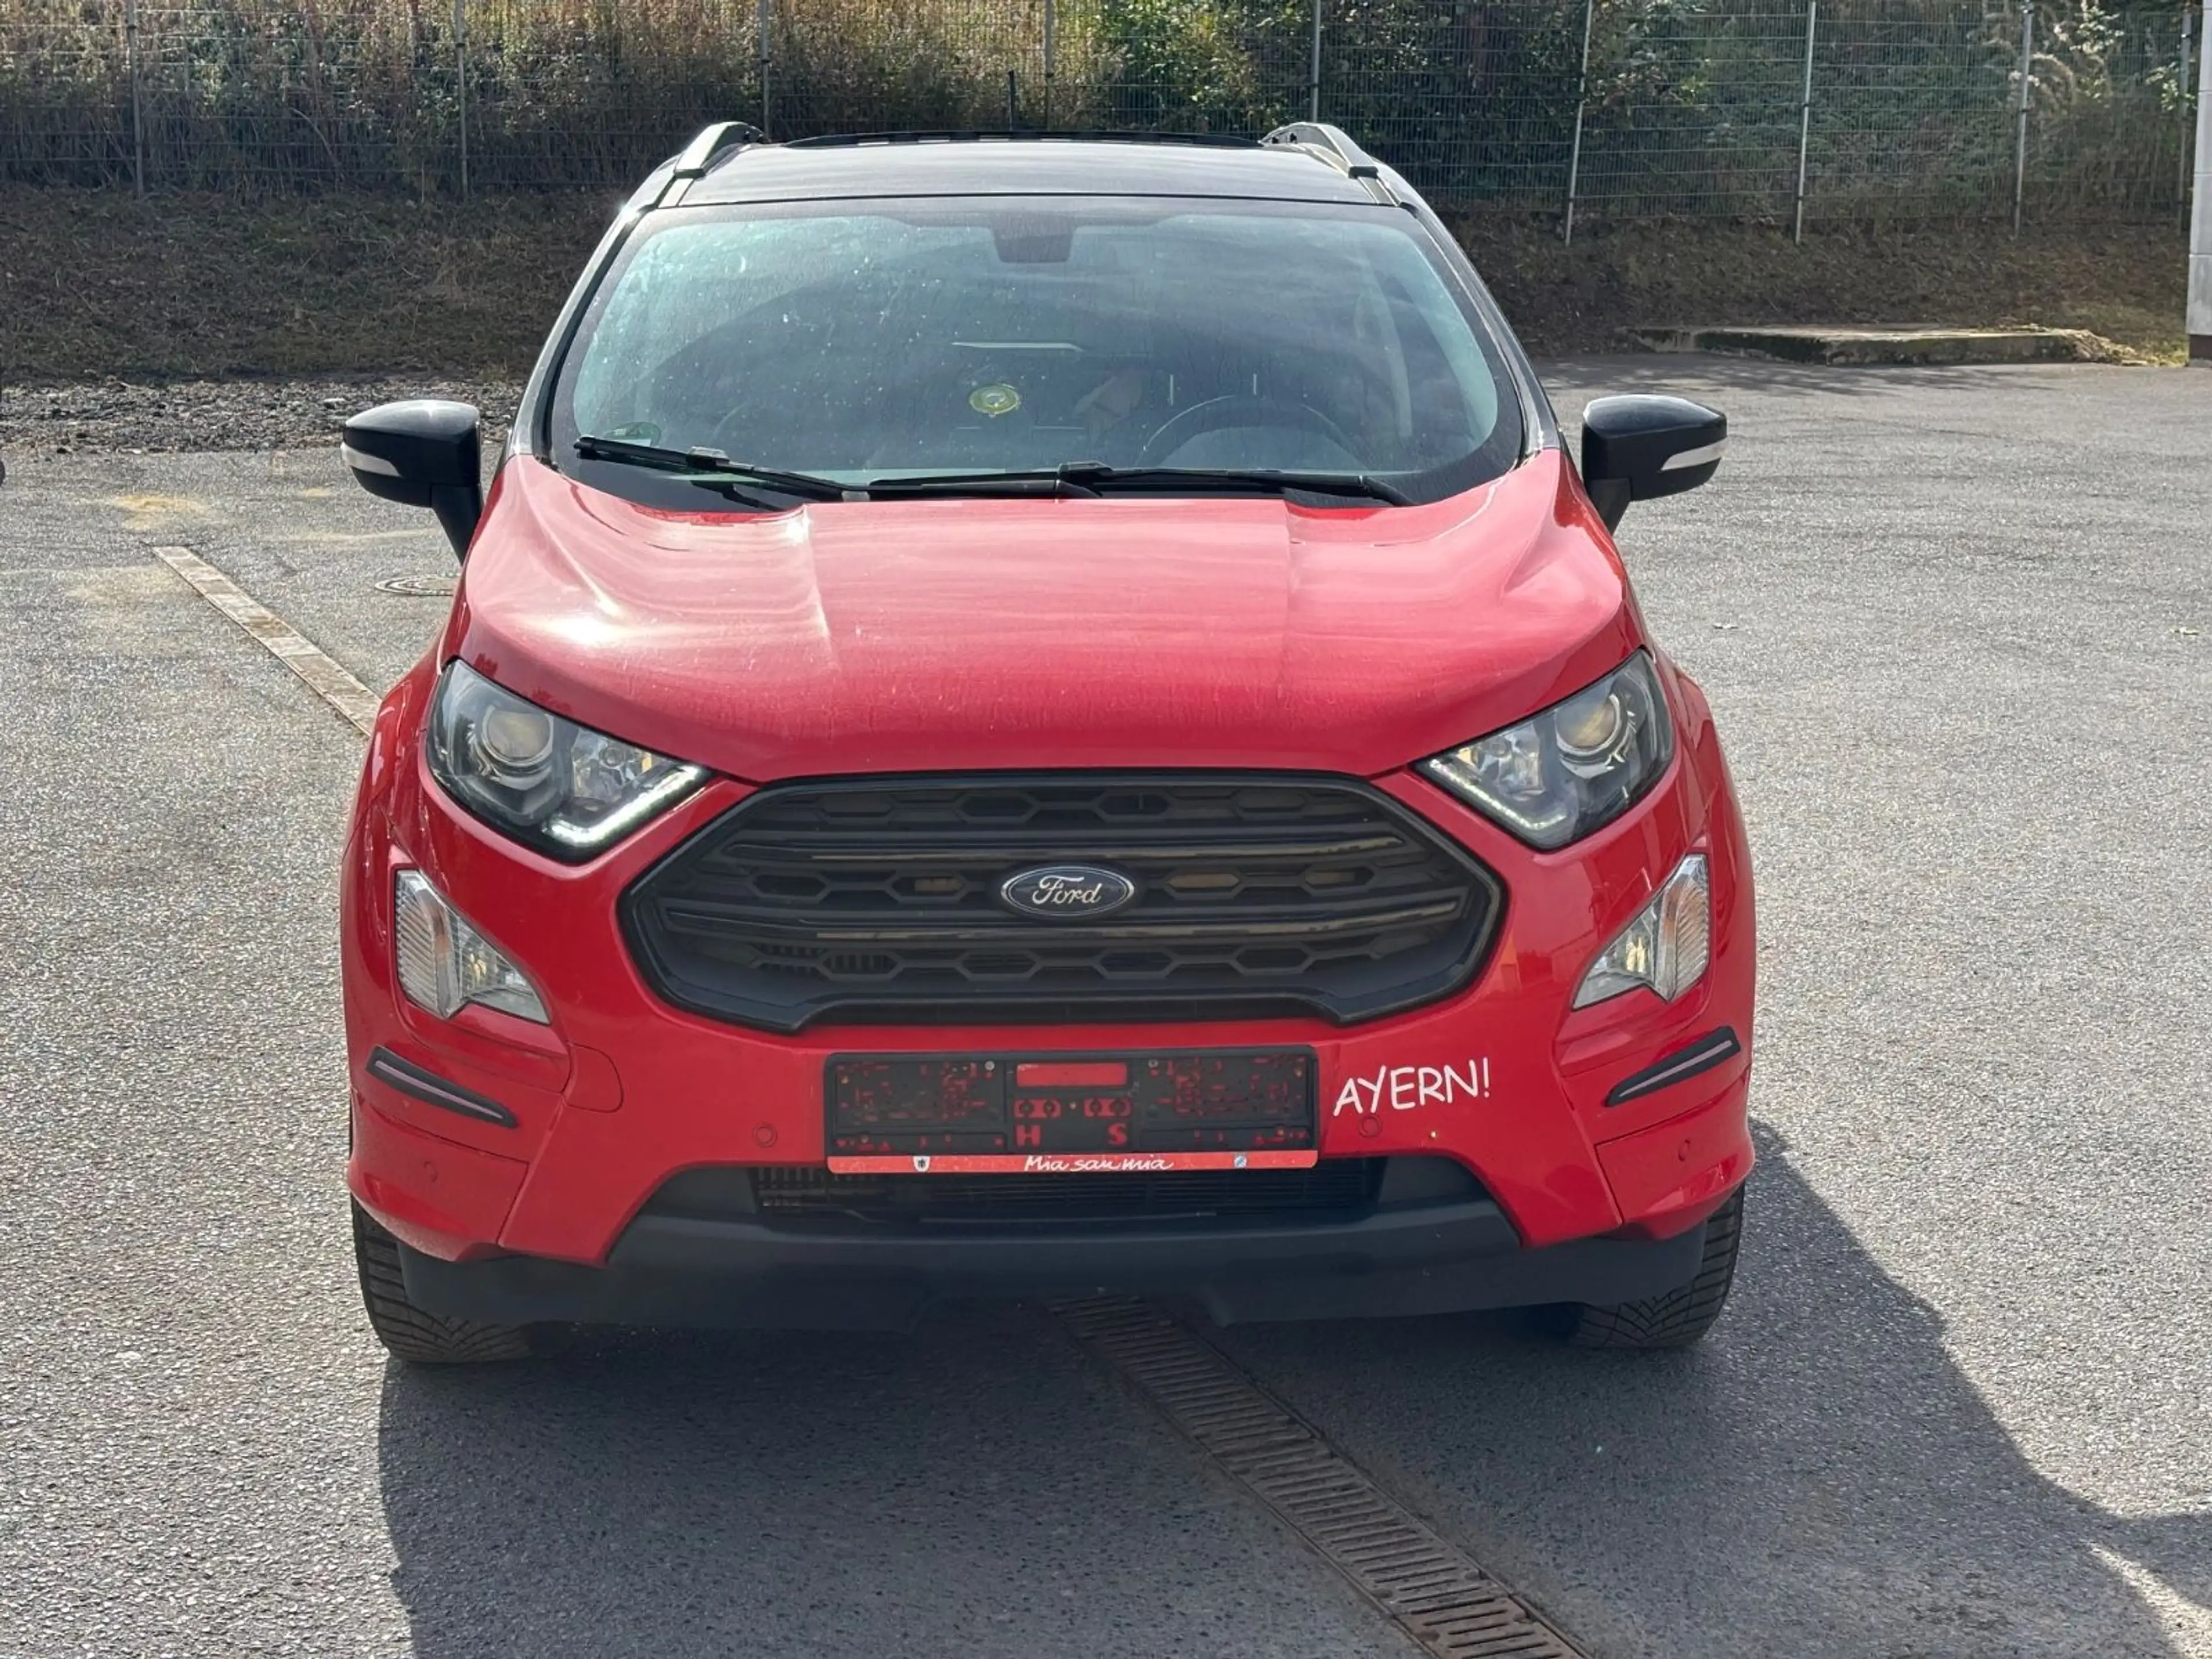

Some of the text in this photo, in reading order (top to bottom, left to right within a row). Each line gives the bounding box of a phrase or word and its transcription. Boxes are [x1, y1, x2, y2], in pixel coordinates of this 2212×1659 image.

[1032, 874, 1103, 904] Ford
[1332, 1057, 1490, 1116] AYERN!
[1024, 1153, 1175, 1172] Mia san mia
